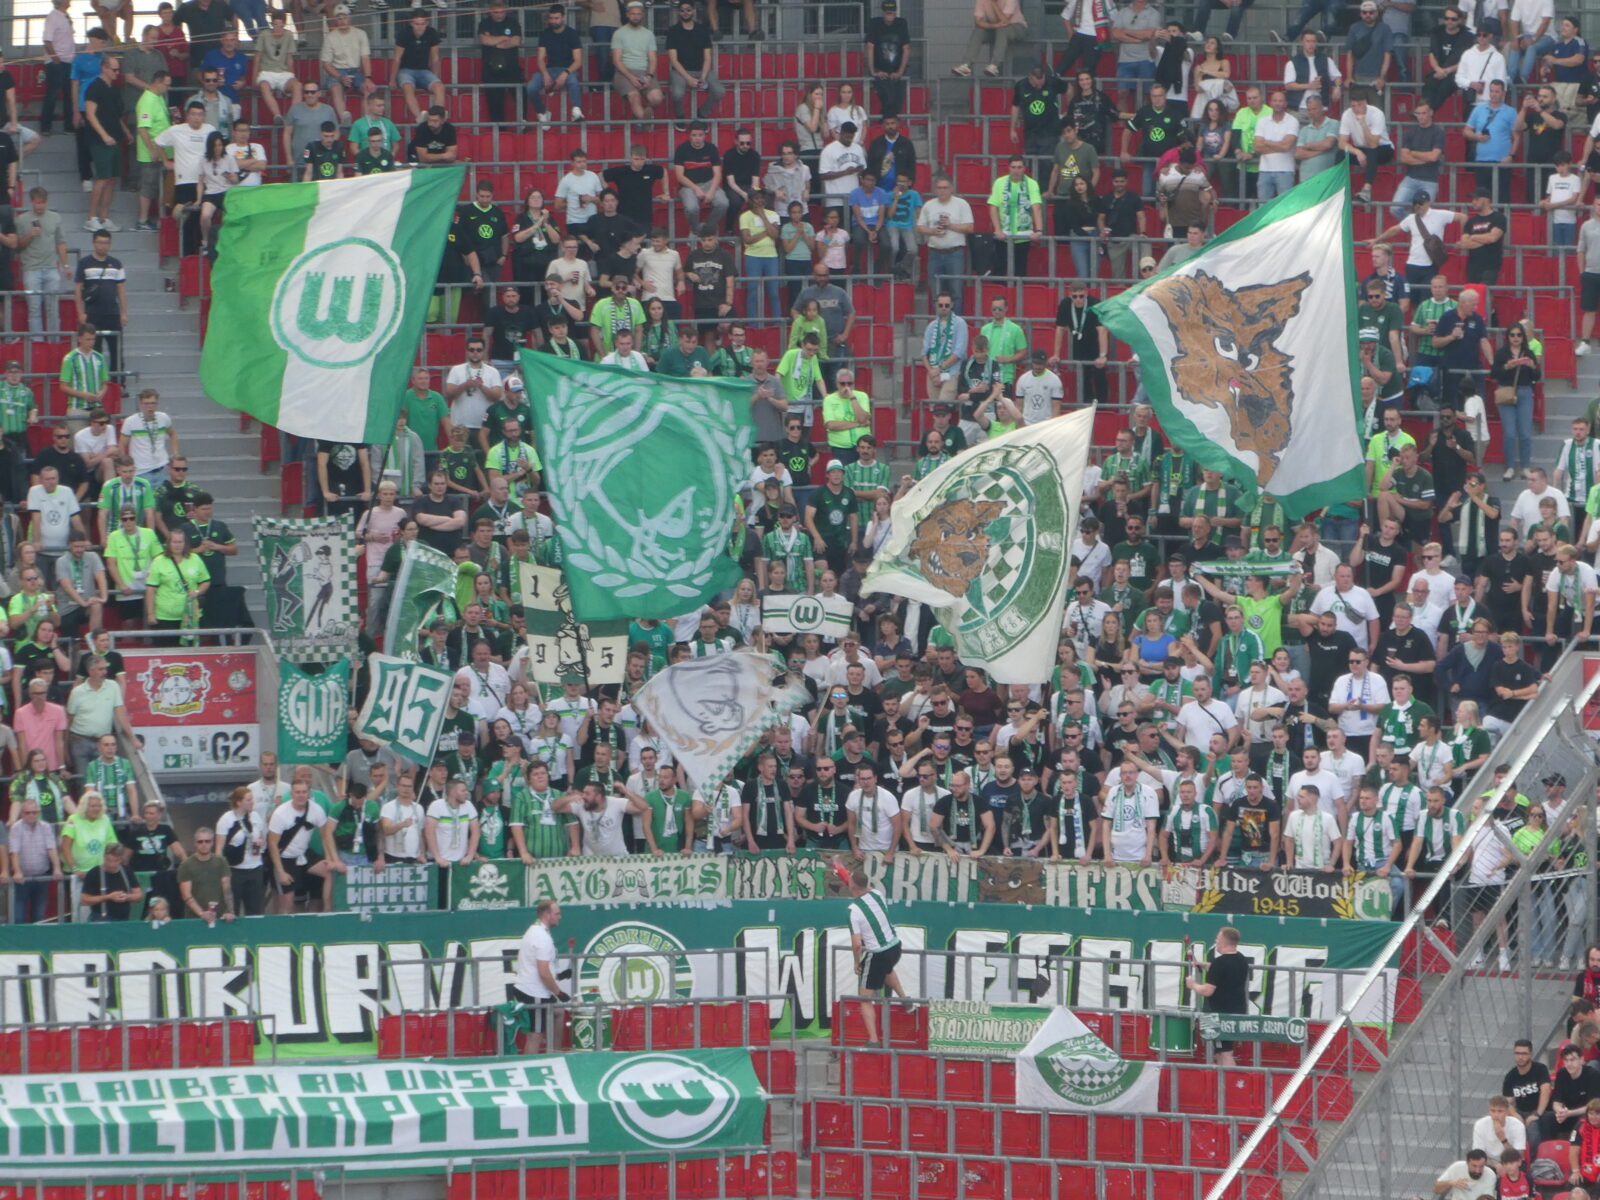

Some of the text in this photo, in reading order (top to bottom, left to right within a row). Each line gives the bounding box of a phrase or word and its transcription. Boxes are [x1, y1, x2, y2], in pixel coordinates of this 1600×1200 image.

[288, 679, 343, 738] GWA
[213, 731, 250, 764] G2
[346, 884, 428, 904] WAPPEN
[1252, 896, 1300, 916] 1945
[26, 1074, 280, 1104] GLAUBEN
[298, 1071, 369, 1094] AN
[385, 1064, 560, 1091] UNSER
[1512, 1082, 1539, 1098] BOSS
